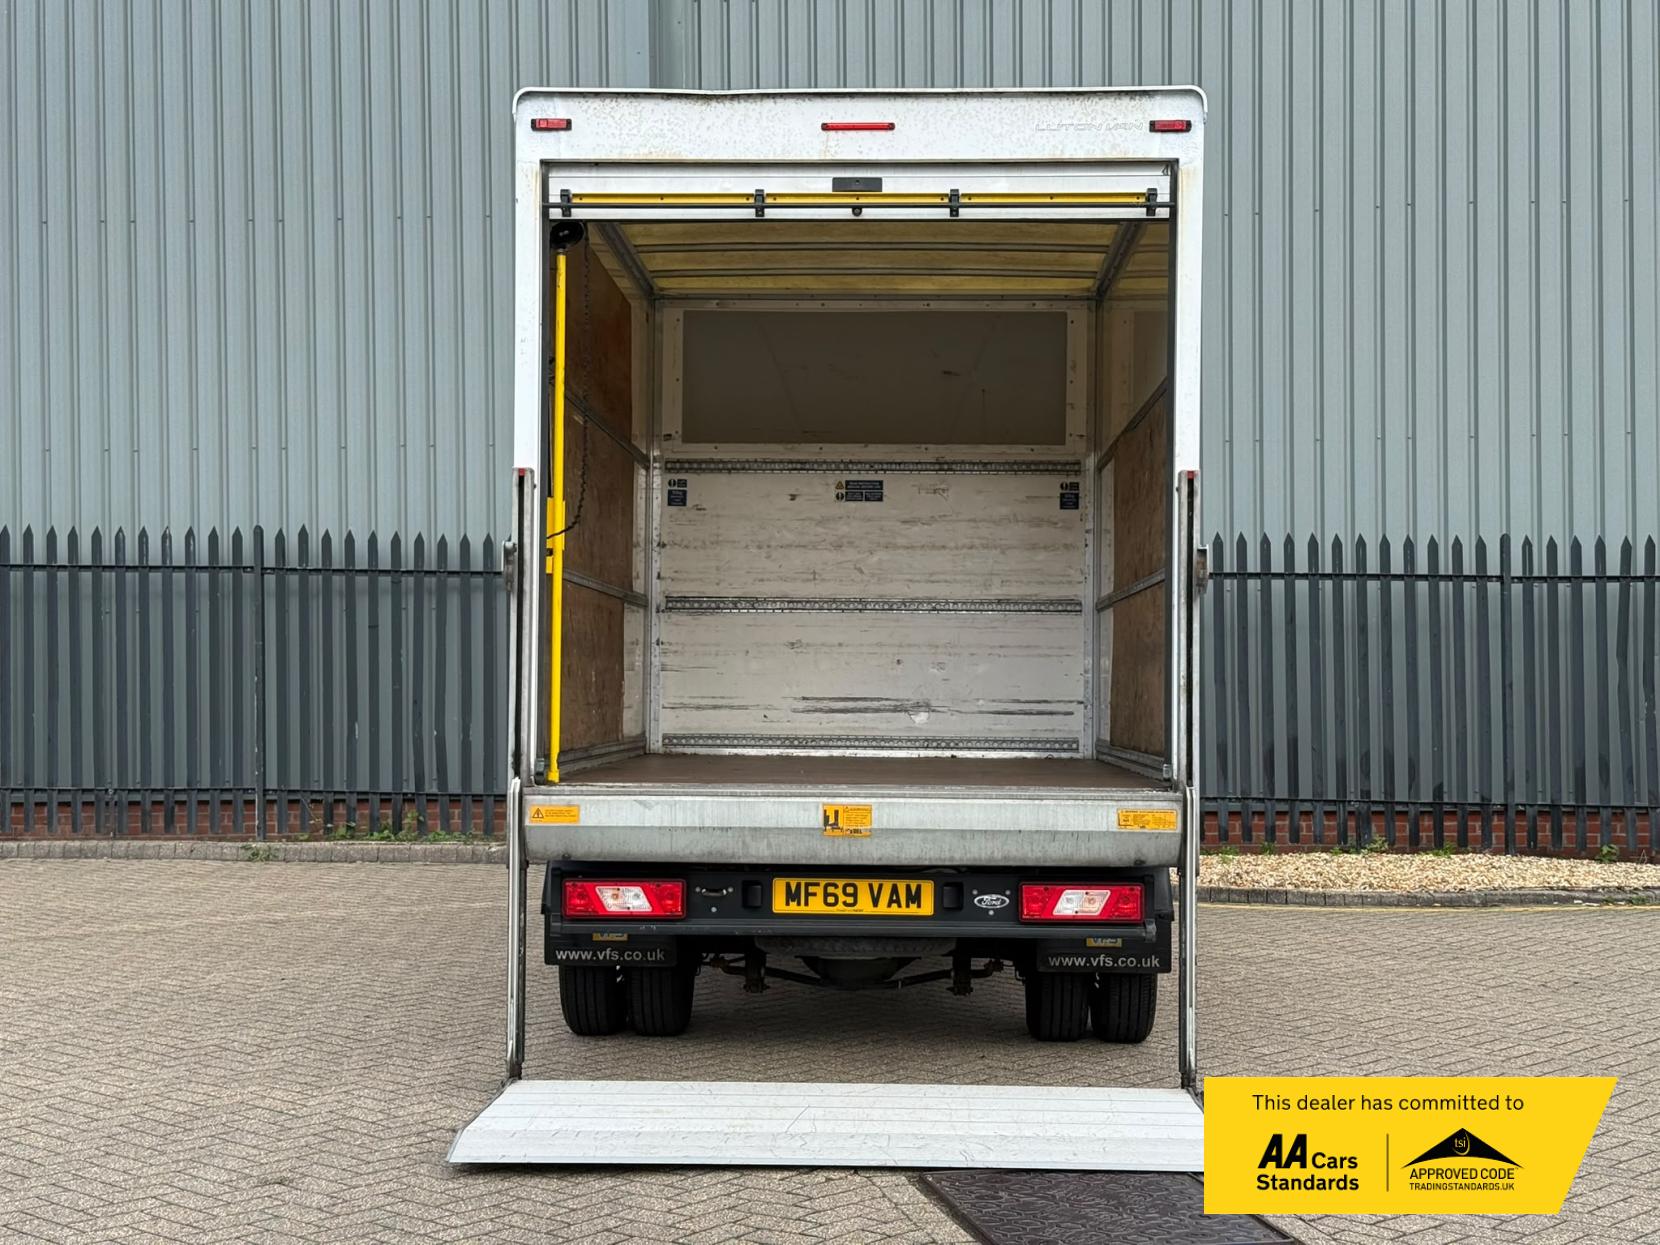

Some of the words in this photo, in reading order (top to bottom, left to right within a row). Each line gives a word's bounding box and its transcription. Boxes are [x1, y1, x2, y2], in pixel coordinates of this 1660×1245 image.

[785, 881, 859, 908] MF69
[868, 882, 922, 909] VAM
[555, 947, 665, 961] www.vfs.co.uk
[1048, 953, 1160, 968] www.vfs.co.uk
